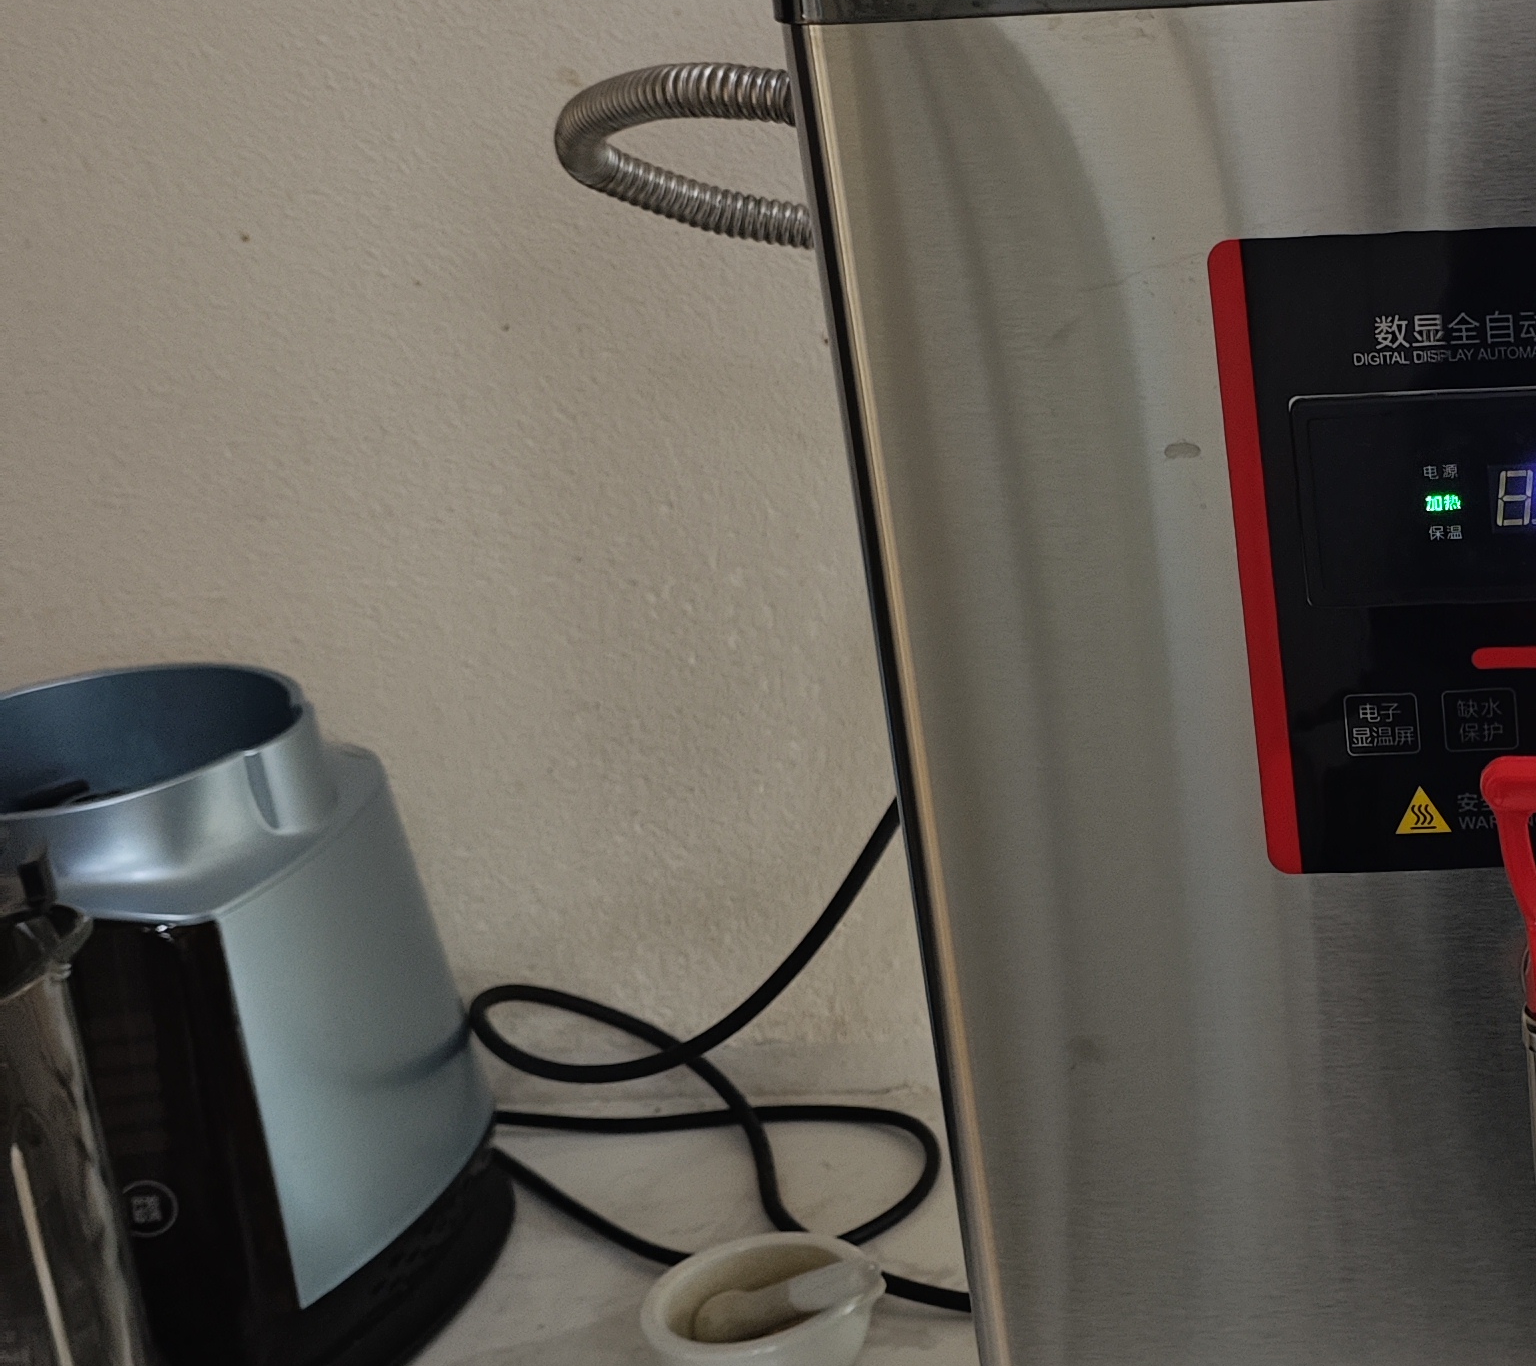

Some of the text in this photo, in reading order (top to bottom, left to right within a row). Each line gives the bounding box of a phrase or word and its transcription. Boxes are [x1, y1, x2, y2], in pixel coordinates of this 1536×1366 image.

[1353, 350, 1410, 366] DIGITAL
[1412, 347, 1475, 363] DISPLAY
[1423, 463, 1458, 480] 电源
[1425, 494, 1462, 512] 加热
[1428, 525, 1463, 541] 保温
[1359, 702, 1402, 724] 电子
[1456, 697, 1503, 719] 缺水
[1351, 726, 1416, 749] 显温屏
[1458, 720, 1504, 743] 保护
